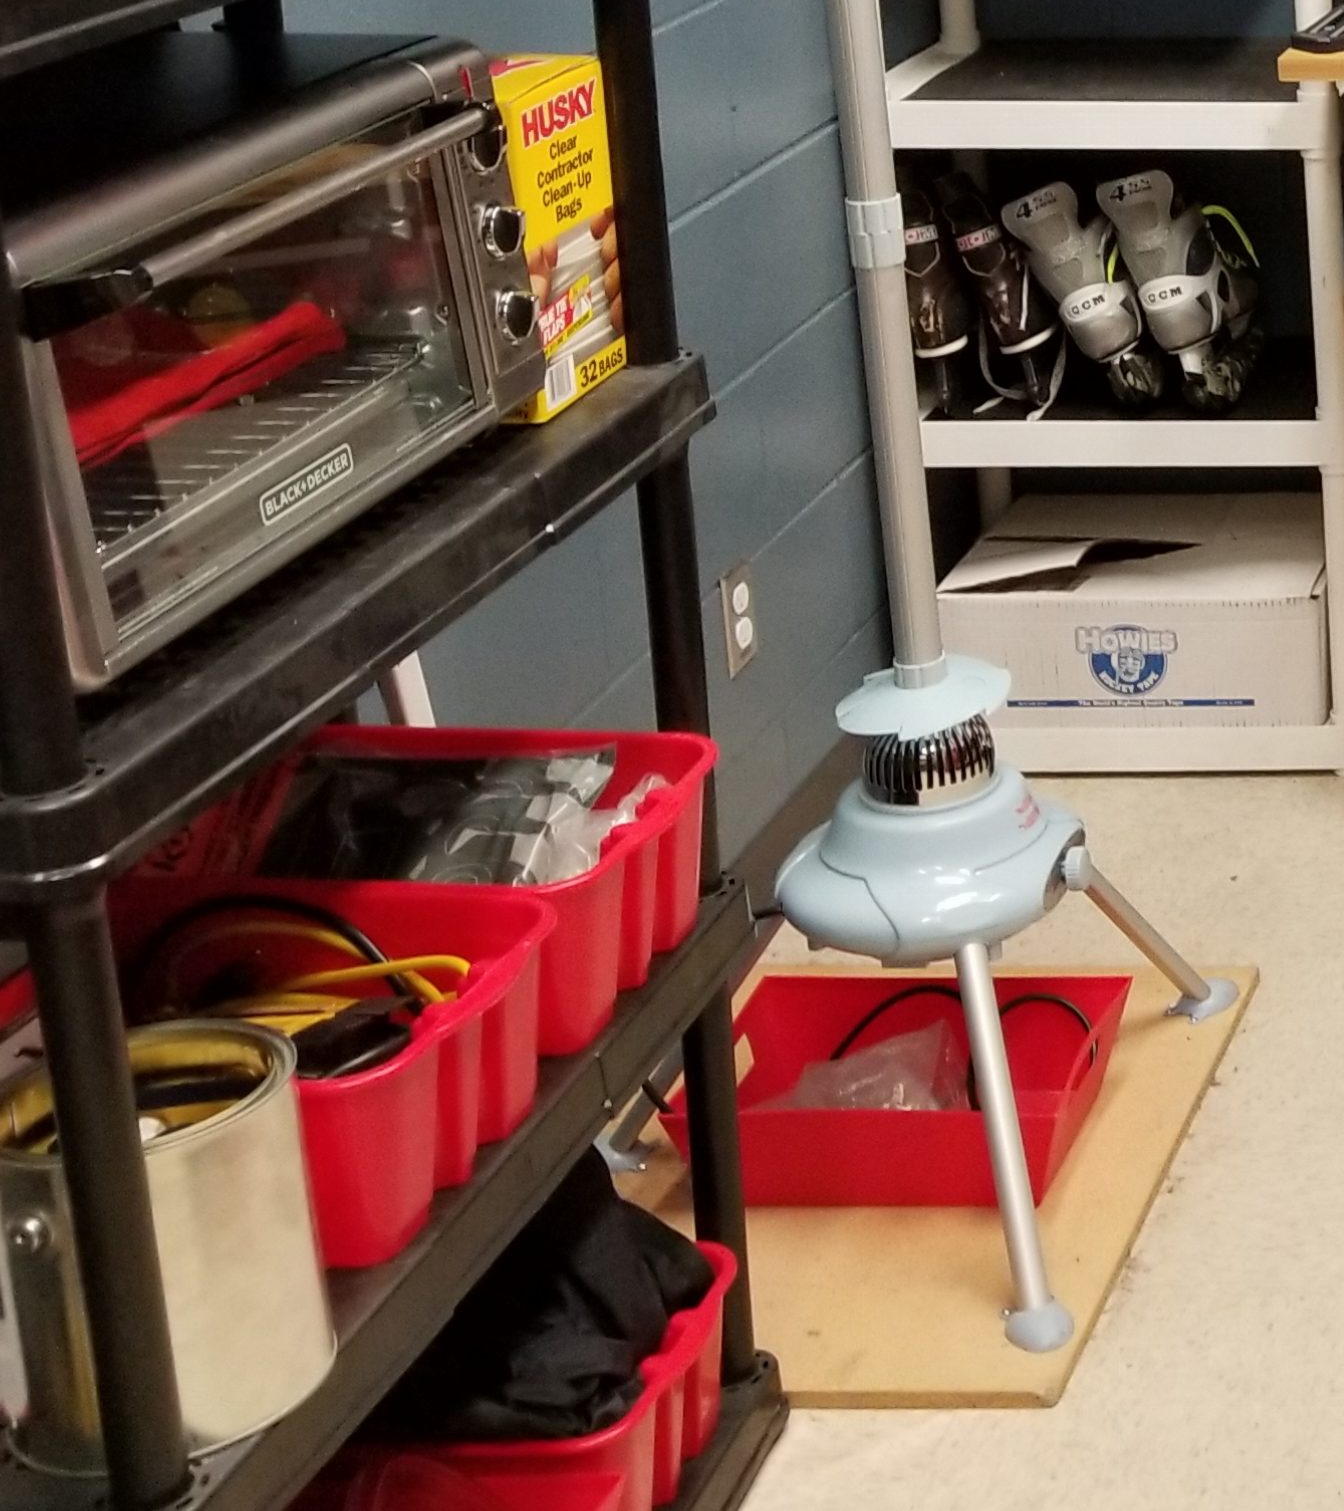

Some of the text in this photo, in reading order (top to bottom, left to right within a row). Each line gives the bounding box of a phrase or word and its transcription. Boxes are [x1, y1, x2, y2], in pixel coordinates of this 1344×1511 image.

[521, 78, 595, 148] HUSKY
[549, 135, 577, 160] Clear
[537, 148, 594, 189] Contractor
[542, 171, 592, 207] Clean-Up
[1109, 183, 1126, 202] 4
[555, 197, 583, 223] Bags
[1016, 202, 1033, 220] 4
[1071, 294, 1106, 316] CCM
[1147, 285, 1183, 304] CCM
[580, 347, 623, 388] 32 BAGS
[1075, 626, 1179, 655] HOWIES
[1138, 671, 1160, 693] TAPE
